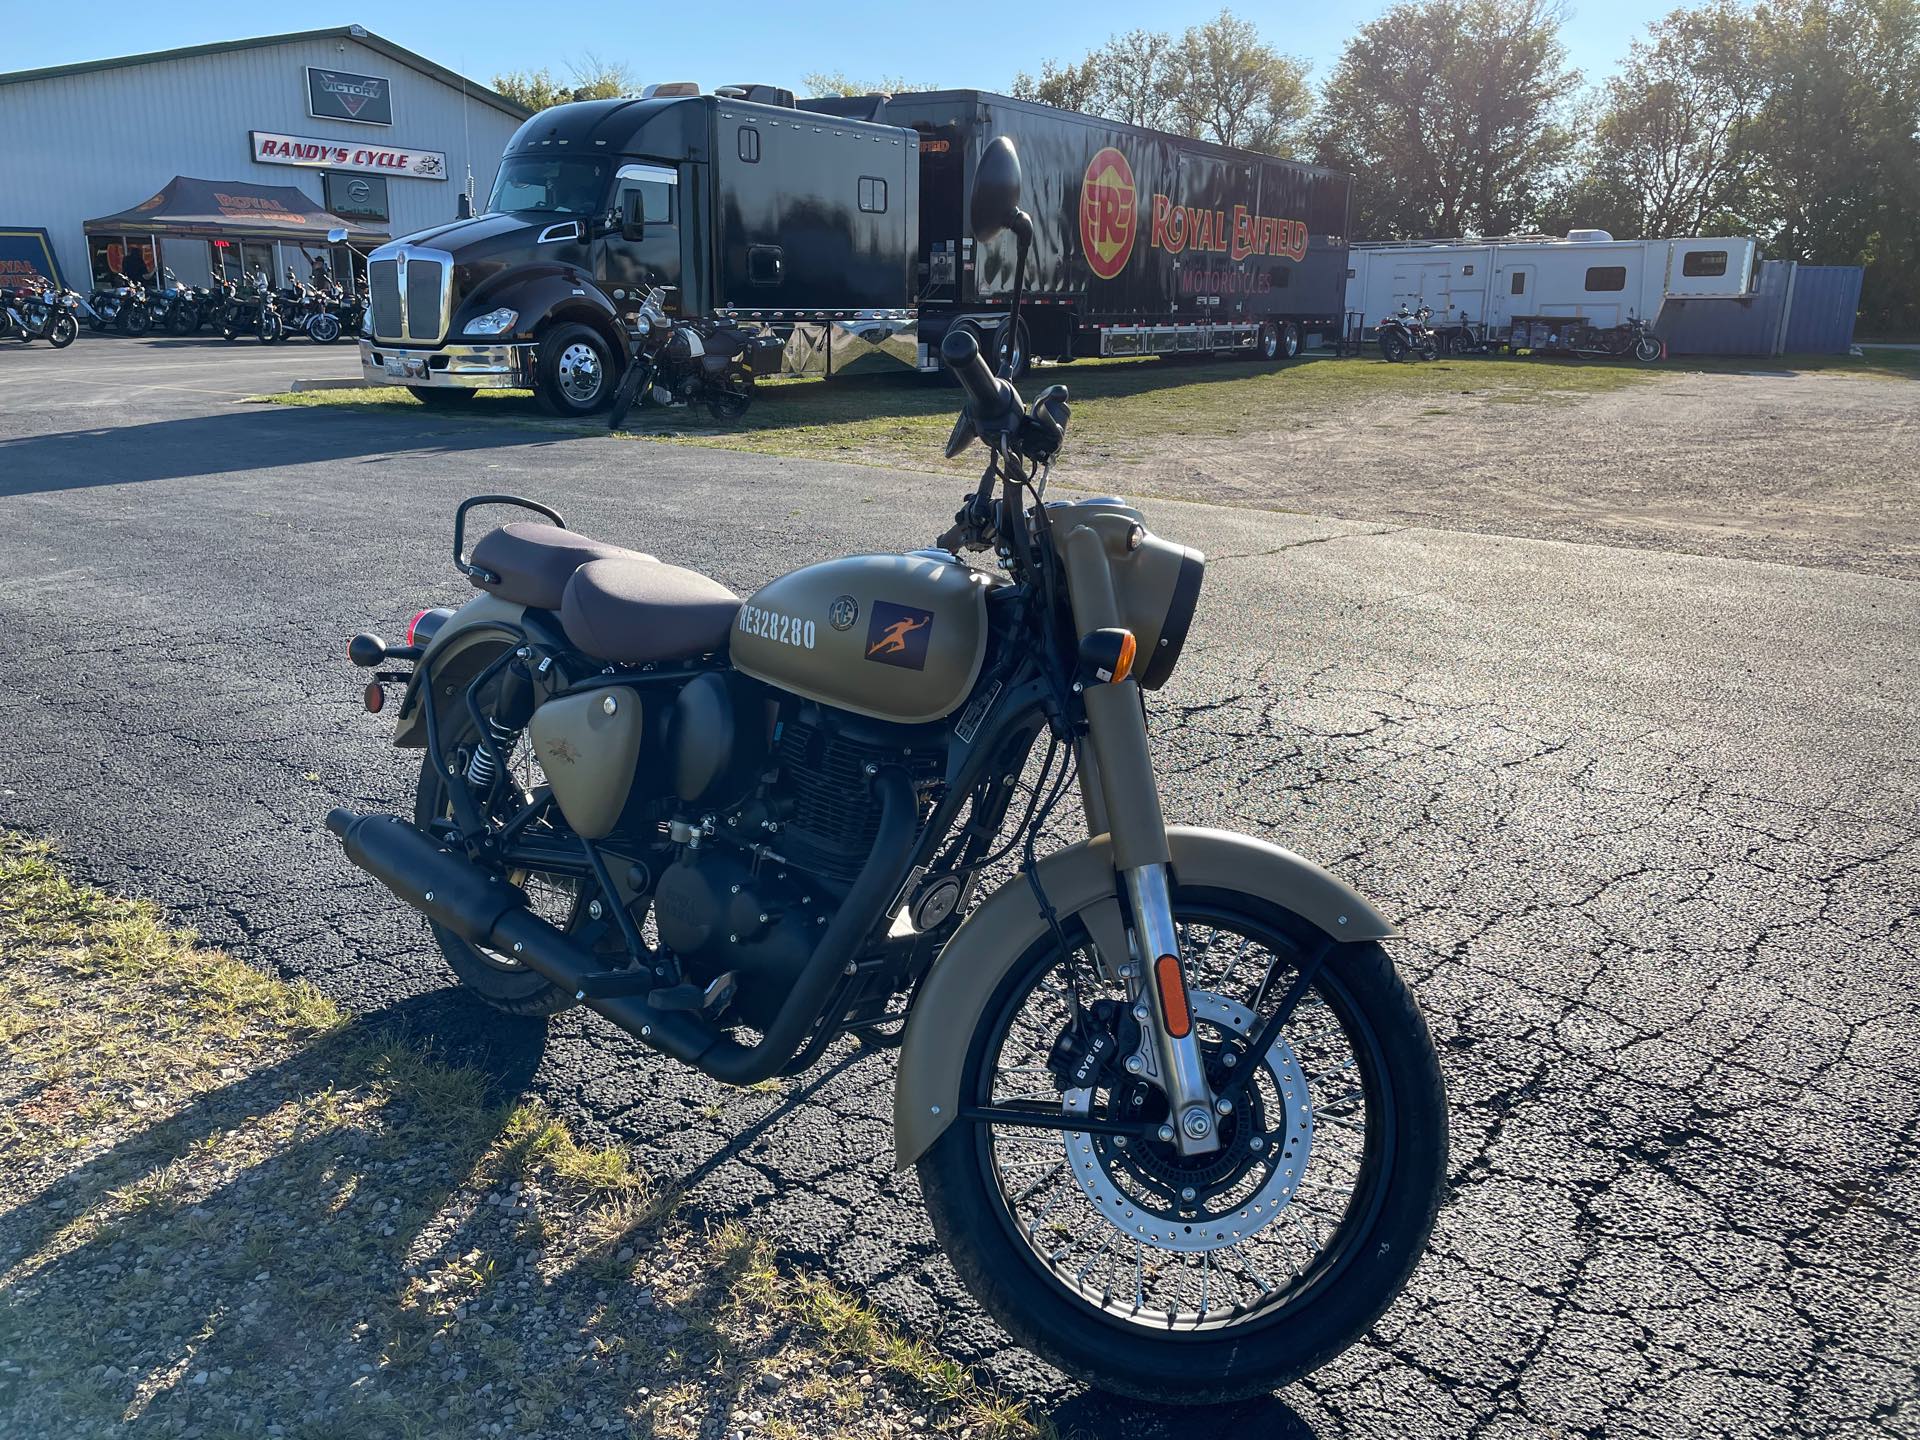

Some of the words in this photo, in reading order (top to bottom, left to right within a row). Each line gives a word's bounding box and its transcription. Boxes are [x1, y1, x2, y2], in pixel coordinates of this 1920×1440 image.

[320, 81, 383, 98] VICTORY
[260, 139, 350, 163] RANDY'S
[353, 149, 409, 169] CYCLE
[214, 193, 288, 211] ROYAL
[1151, 194, 1228, 254] ROYAL
[1231, 204, 1309, 262] ENFIELD
[1182, 269, 1273, 295] MOTORCYCLES
[738, 604, 816, 650] RE328280
